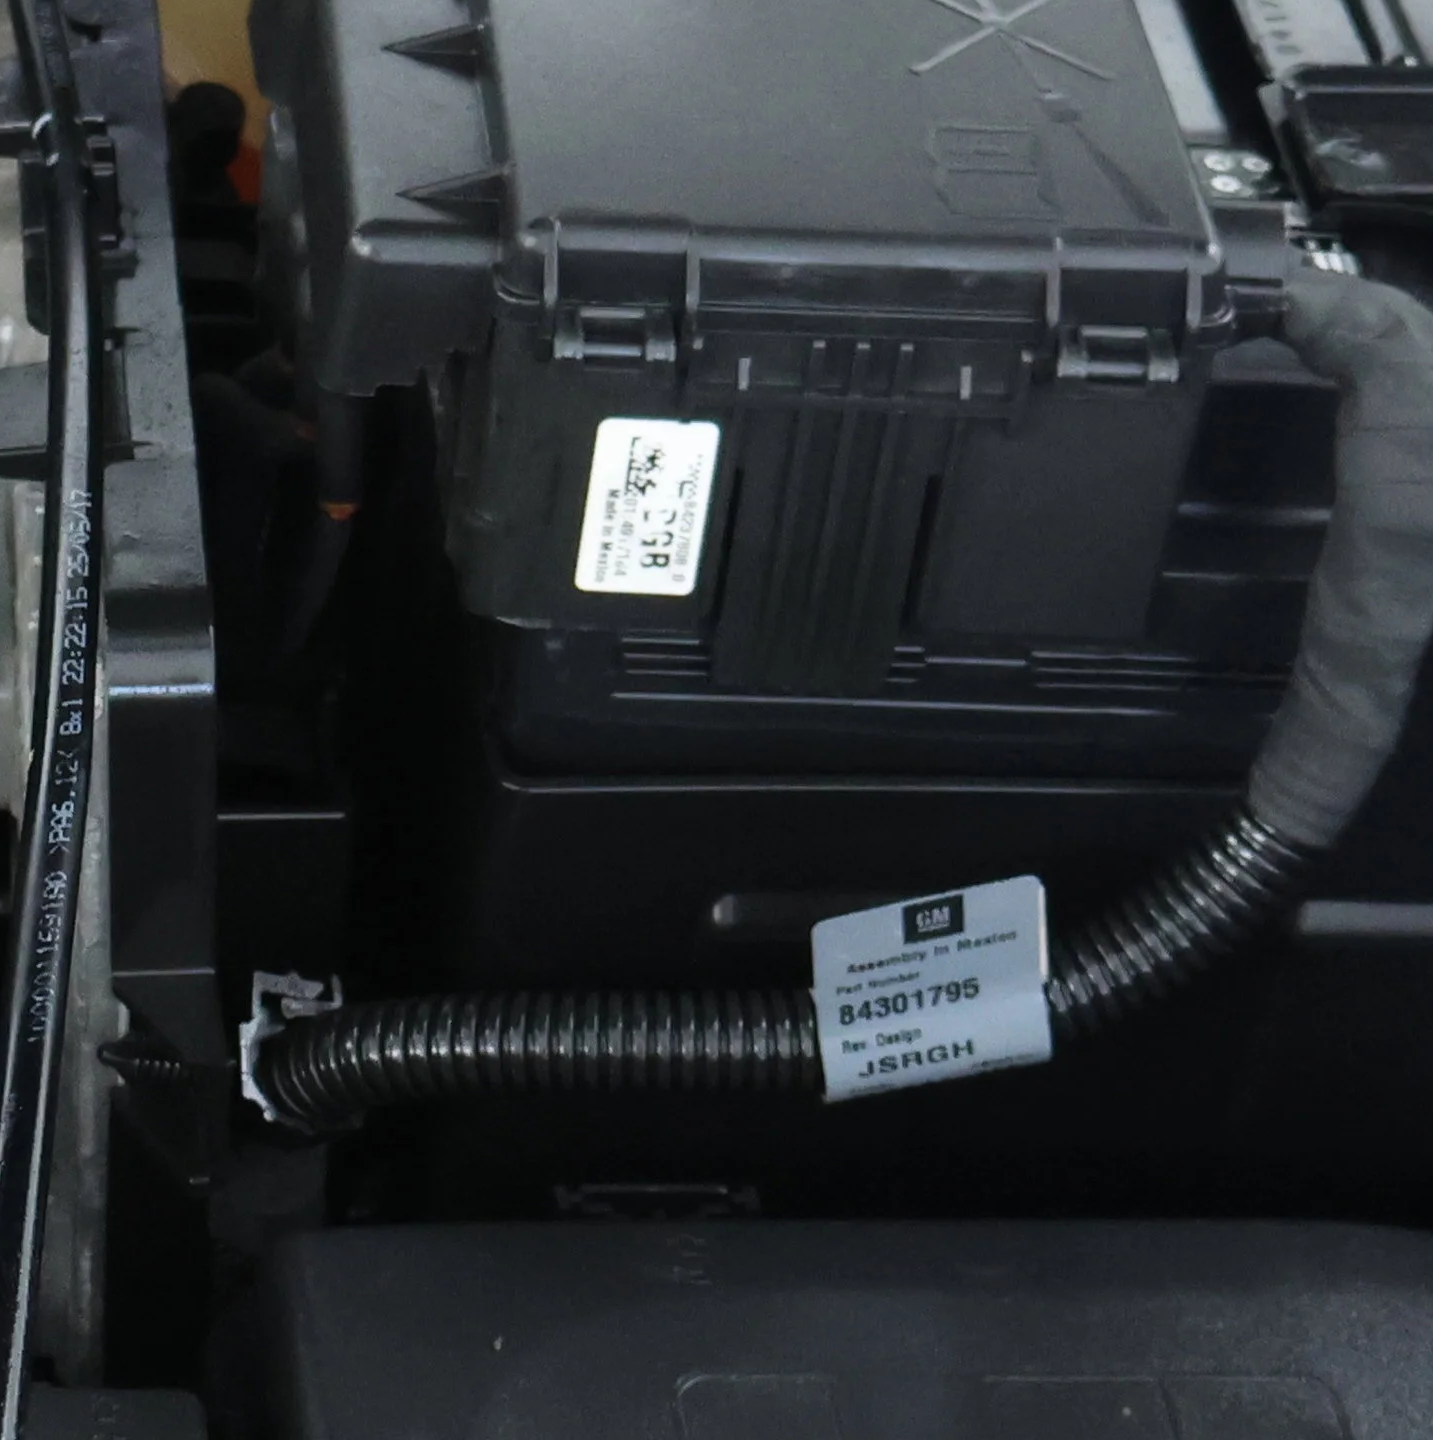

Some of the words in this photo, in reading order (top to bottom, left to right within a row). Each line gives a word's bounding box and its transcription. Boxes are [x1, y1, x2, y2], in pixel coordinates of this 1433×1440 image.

[66, 489, 93, 579] 25/05/17
[61, 587, 89, 686] 22:22:15
[915, 905, 951, 929] GM
[846, 949, 927, 975] Assembly
[957, 929, 1018, 954] Mexico
[838, 977, 981, 1027] 84301795
